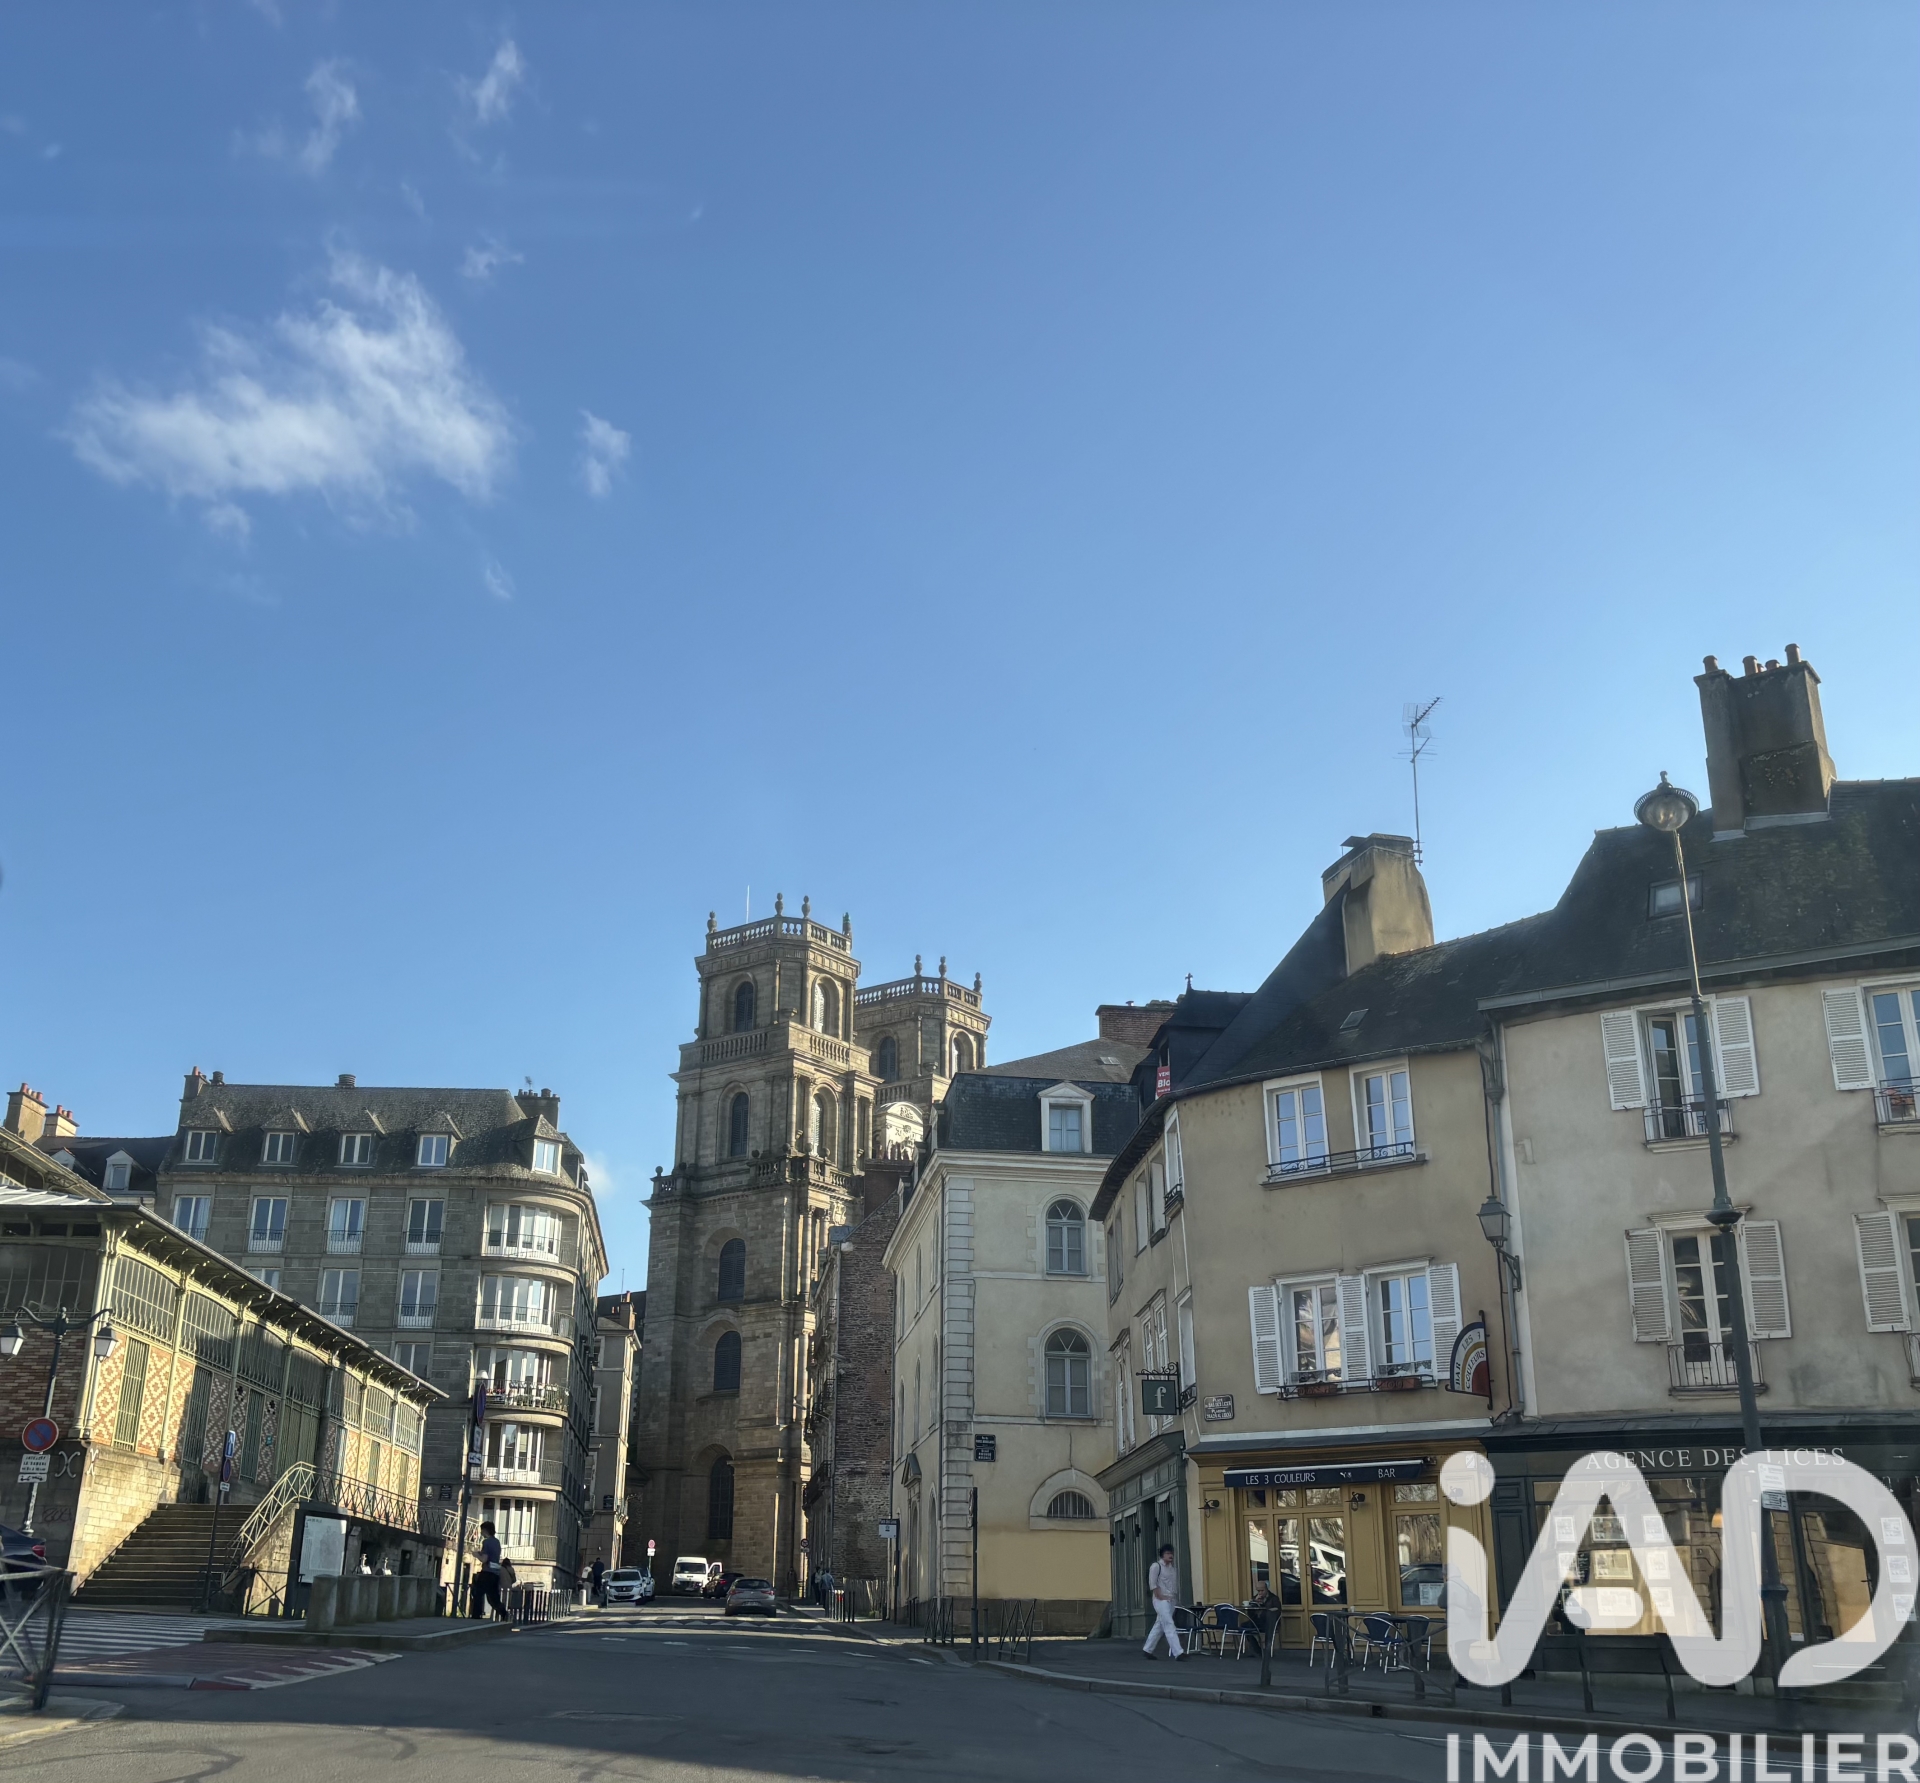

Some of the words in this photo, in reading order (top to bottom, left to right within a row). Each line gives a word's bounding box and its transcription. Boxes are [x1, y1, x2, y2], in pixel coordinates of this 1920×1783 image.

[1154, 1386, 1167, 1409] f
[1585, 1449, 1692, 1470] AGENCE
[1764, 1447, 1846, 1466] LICES
[1245, 1475, 1259, 1485] LES
[1264, 1474, 1270, 1484] 3
[1274, 1472, 1316, 1484] COULEURS
[1377, 1468, 1396, 1479] BAR
